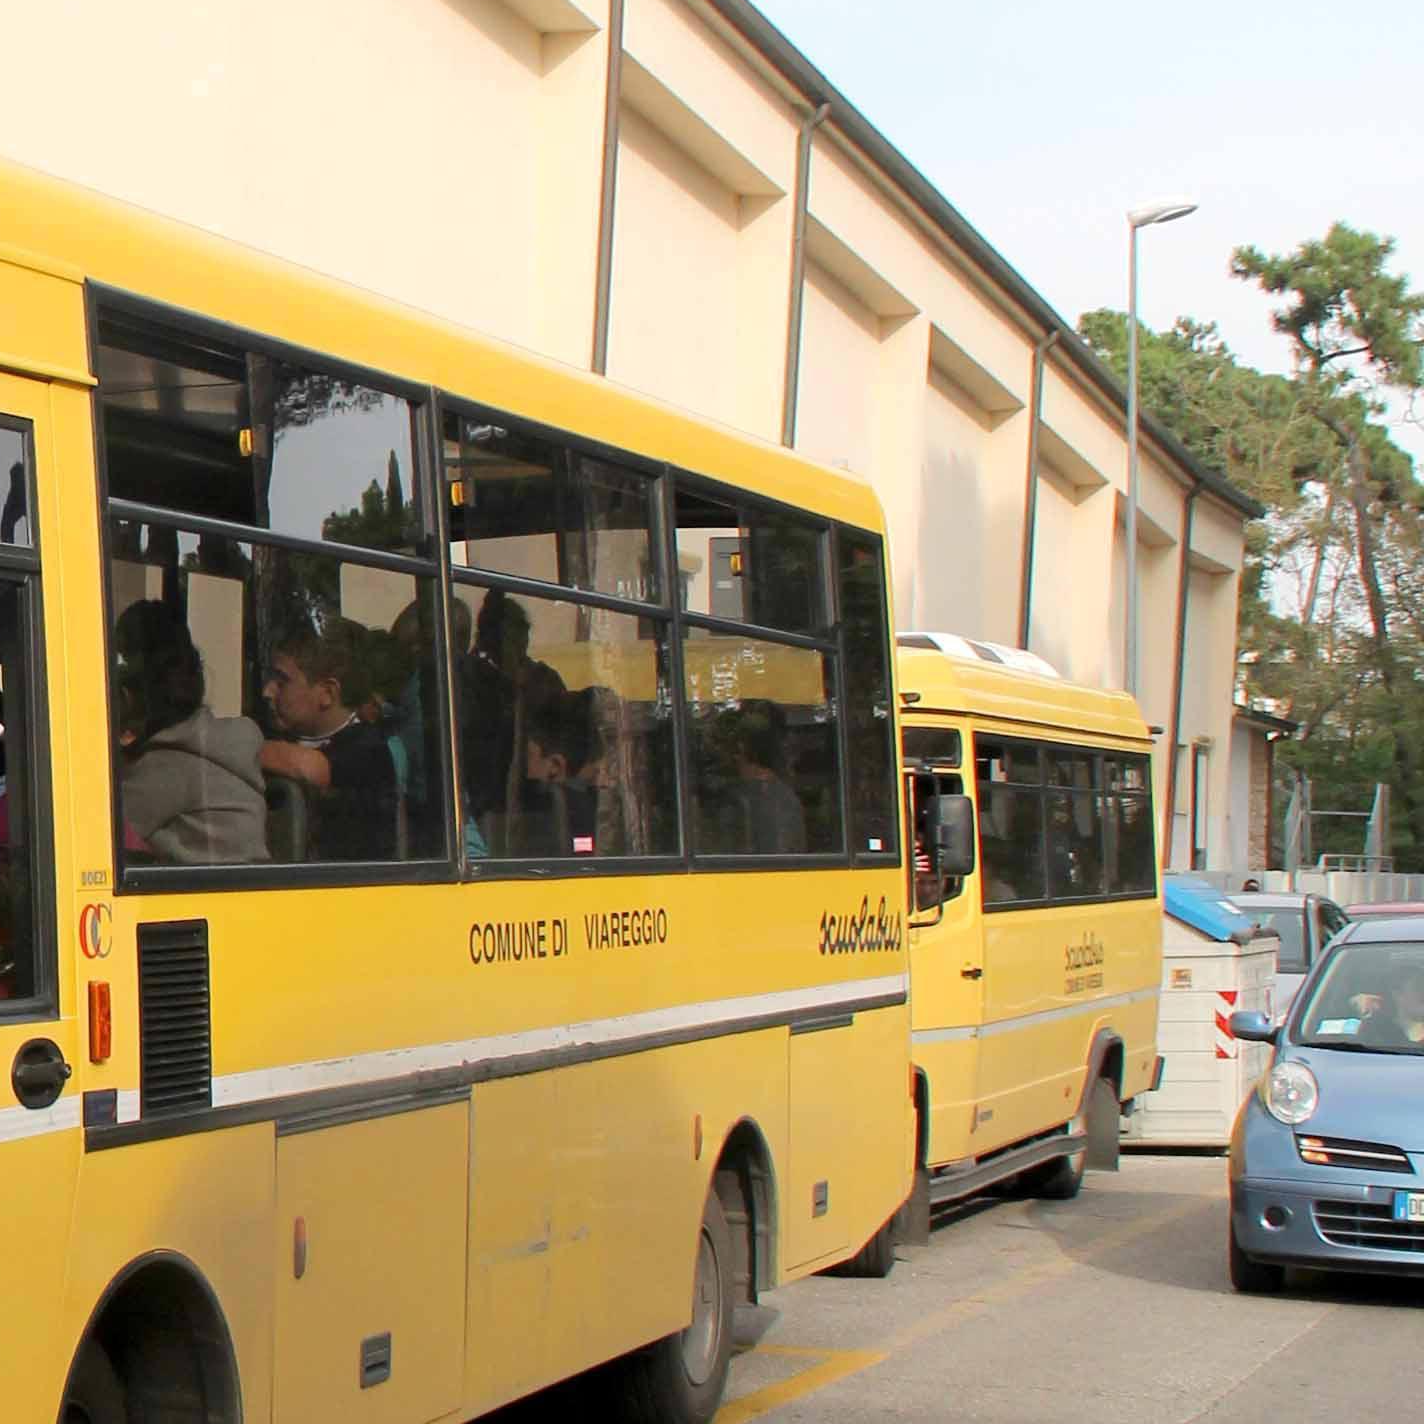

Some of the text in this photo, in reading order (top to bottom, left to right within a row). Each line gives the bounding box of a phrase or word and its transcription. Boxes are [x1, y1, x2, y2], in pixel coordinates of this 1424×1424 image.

[469, 908, 668, 964] COMUNE DI VIAREGGIO
[819, 894, 902, 955] scuolabus
